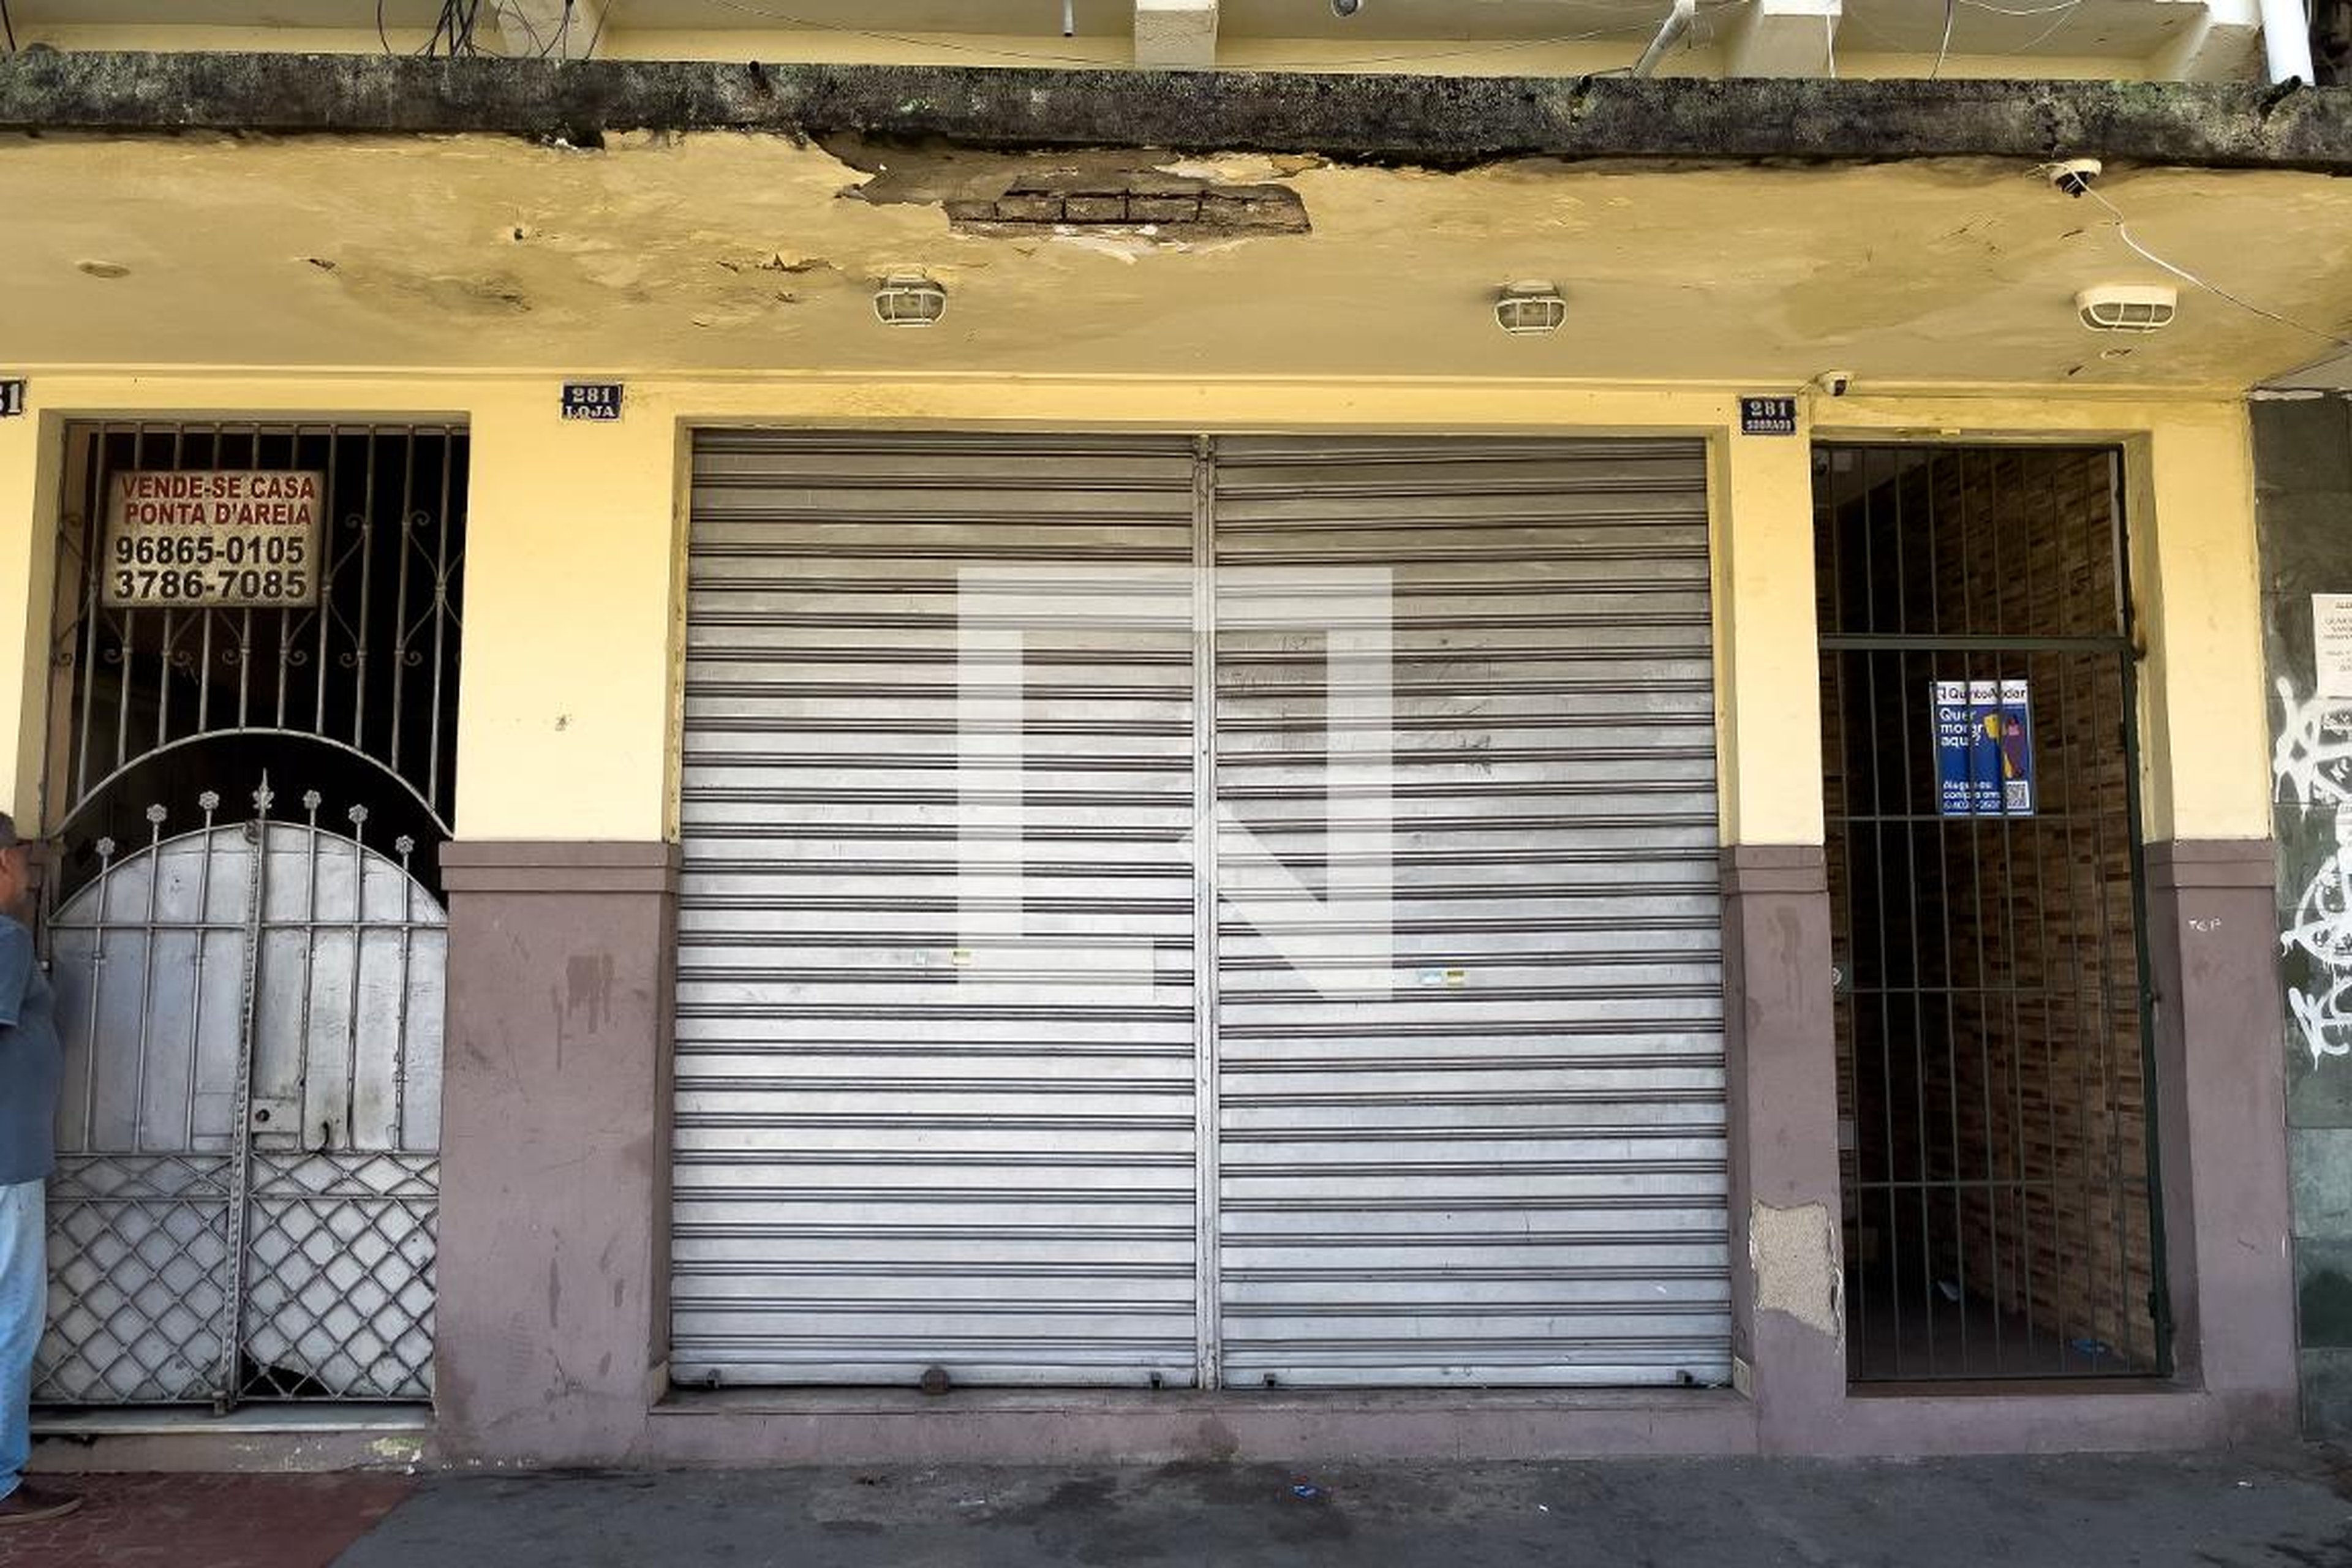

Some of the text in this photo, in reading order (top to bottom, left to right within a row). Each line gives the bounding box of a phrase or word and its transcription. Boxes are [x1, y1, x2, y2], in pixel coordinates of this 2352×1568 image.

[0, 383, 21, 413] 1
[571, 388, 610, 403] 281
[565, 405, 616, 419] LOJA
[1751, 401, 1787, 417] 281
[122, 477, 315, 499] VENDE-SE CASA
[124, 503, 312, 525] PONTA D'AREIA
[116, 536, 304, 564] 96865-0105
[115, 570, 306, 598] 3786-7085
[1939, 707, 1977, 722] Quer
